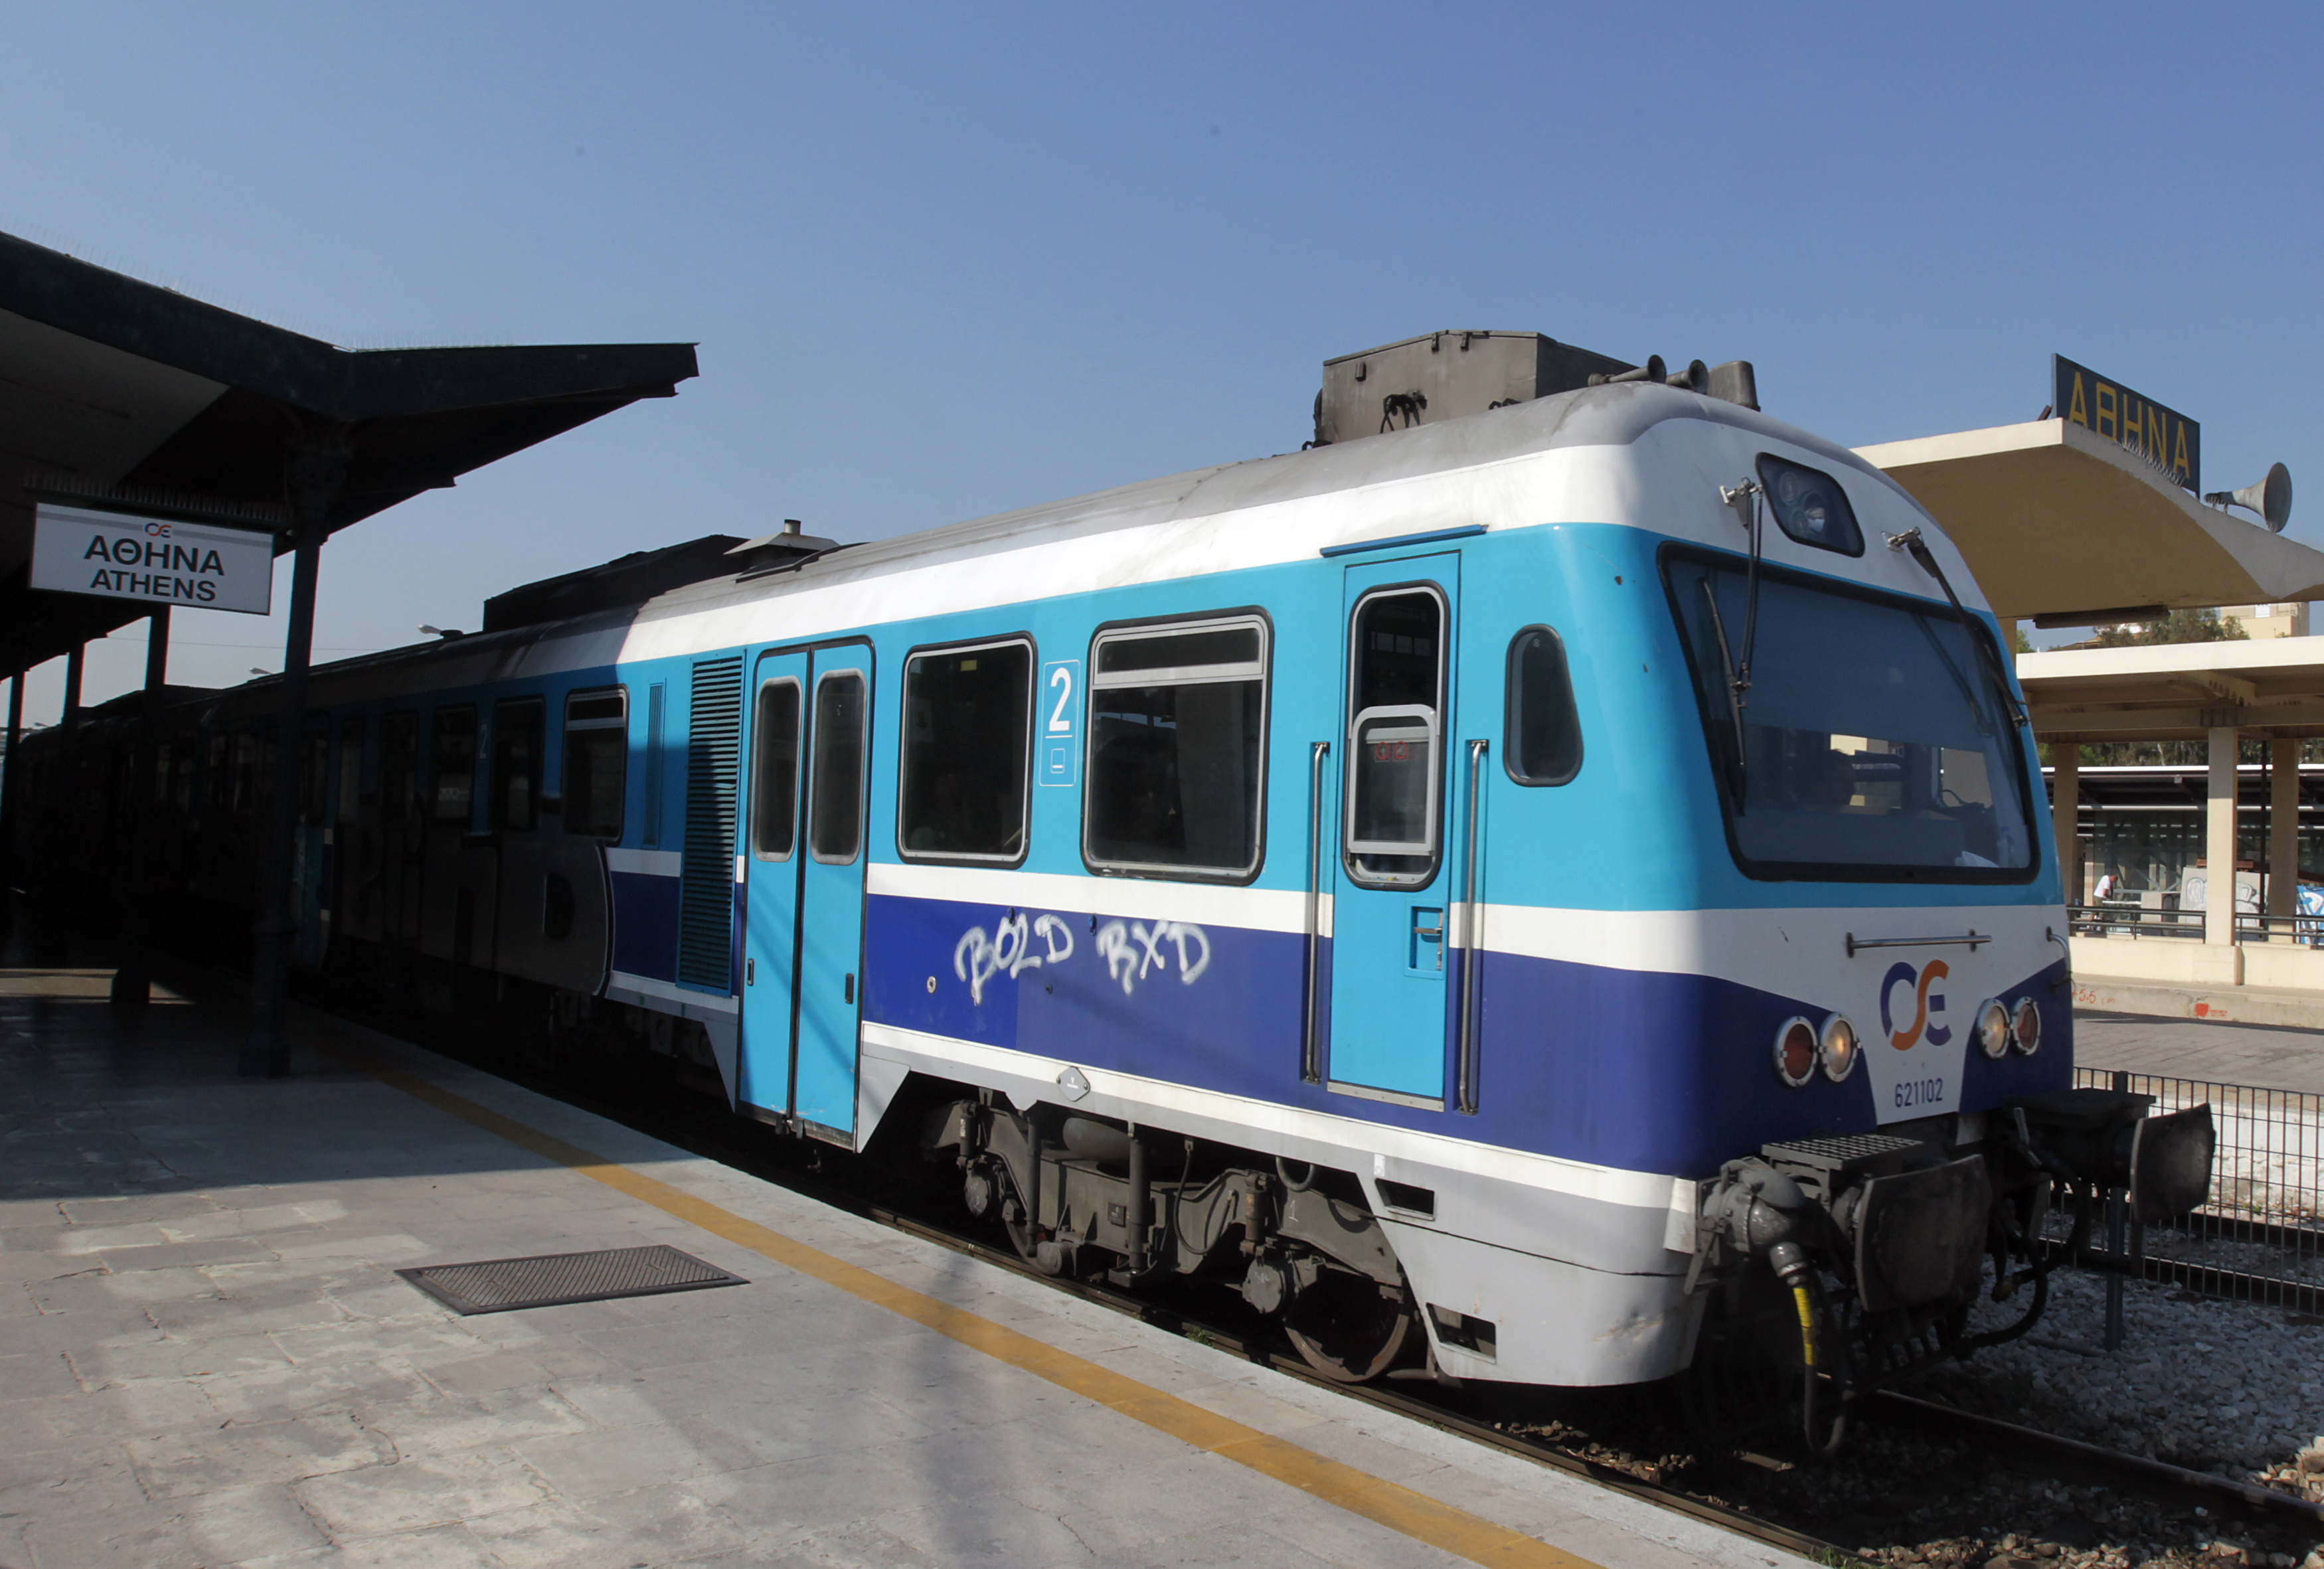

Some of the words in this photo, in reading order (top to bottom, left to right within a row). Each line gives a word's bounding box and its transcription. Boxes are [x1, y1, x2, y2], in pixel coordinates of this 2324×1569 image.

[84, 535, 224, 576] ΑΘΗΝΑ
[90, 569, 216, 602] ATHENS
[1049, 667, 1072, 731] 2
[479, 722, 487, 758] 2
[1895, 1077, 1943, 1108] 621102
